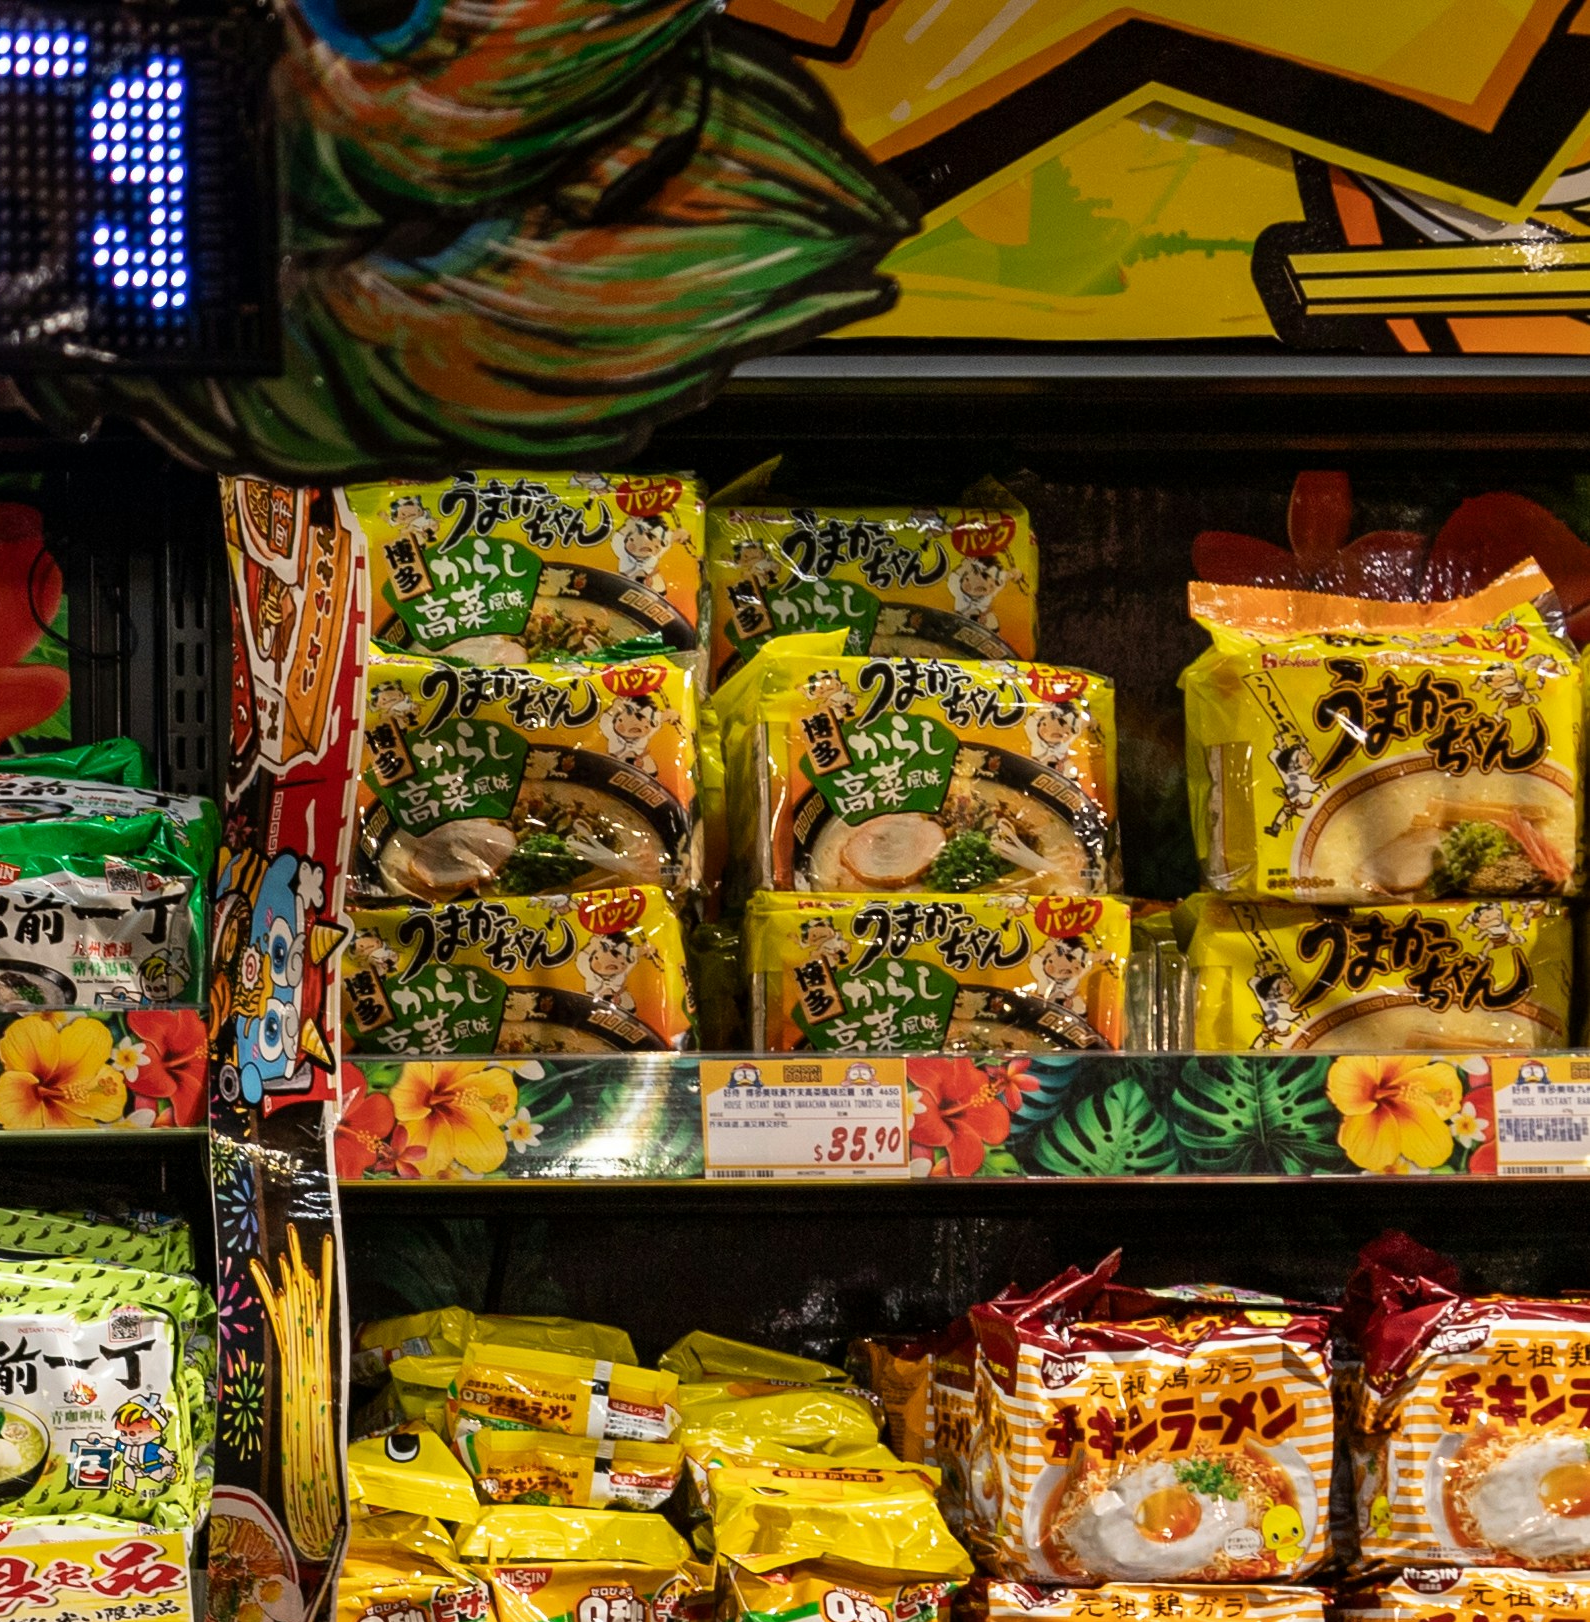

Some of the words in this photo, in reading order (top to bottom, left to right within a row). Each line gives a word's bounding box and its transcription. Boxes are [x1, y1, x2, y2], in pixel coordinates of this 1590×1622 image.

[438, 470, 611, 553] うまかっちゃん
[384, 541, 422, 594] 博多
[430, 540, 527, 585] からし
[420, 664, 600, 736] うまかっちゃん
[856, 658, 1025, 729] うまかっちゃん
[1314, 657, 1547, 780] うまかっちゃん
[399, 904, 576, 983] うまかっちゃん
[1292, 908, 1533, 1012] うまかっちゃん
[814, 1127, 901, 1162] $35.90
[1045, 1386, 1296, 1460] チキンラーメン
[500, 1570, 546, 1584] NISSIN
